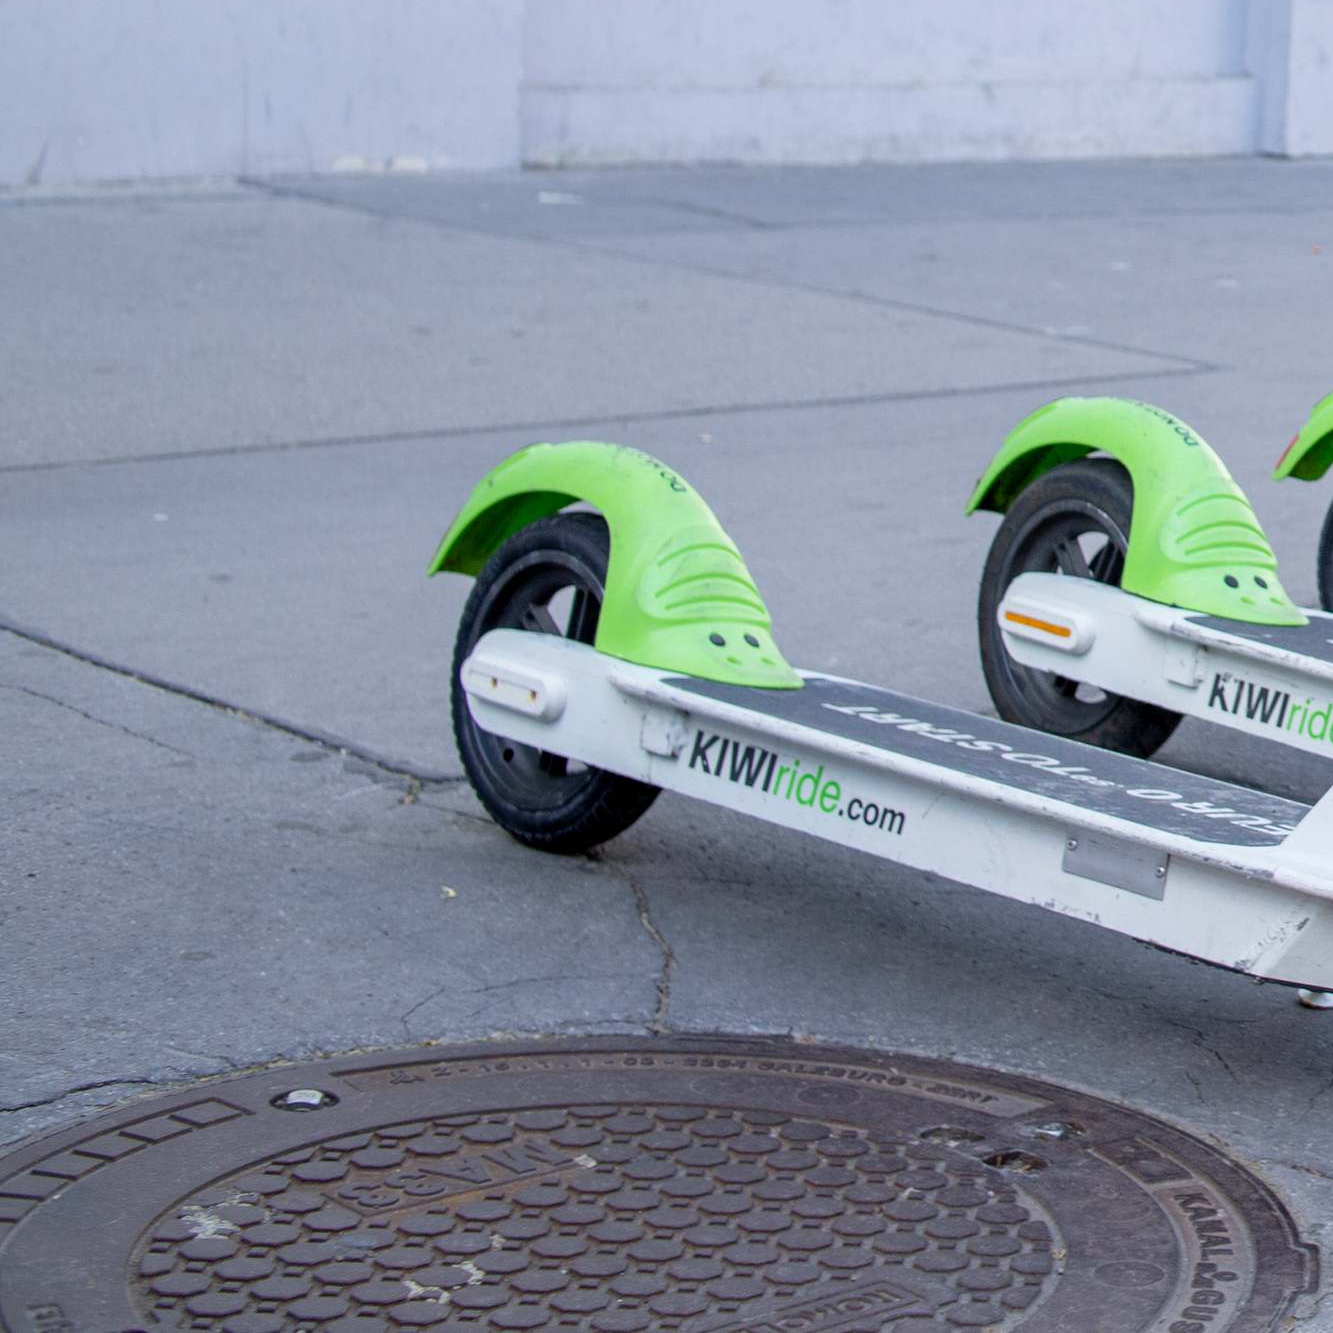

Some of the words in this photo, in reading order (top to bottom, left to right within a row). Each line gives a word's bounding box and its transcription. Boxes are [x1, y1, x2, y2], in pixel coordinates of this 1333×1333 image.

[820, 702, 1014, 753] START
[688, 729, 906, 835] KIWIride.com
[1173, 1192, 1235, 1262] KANAL
